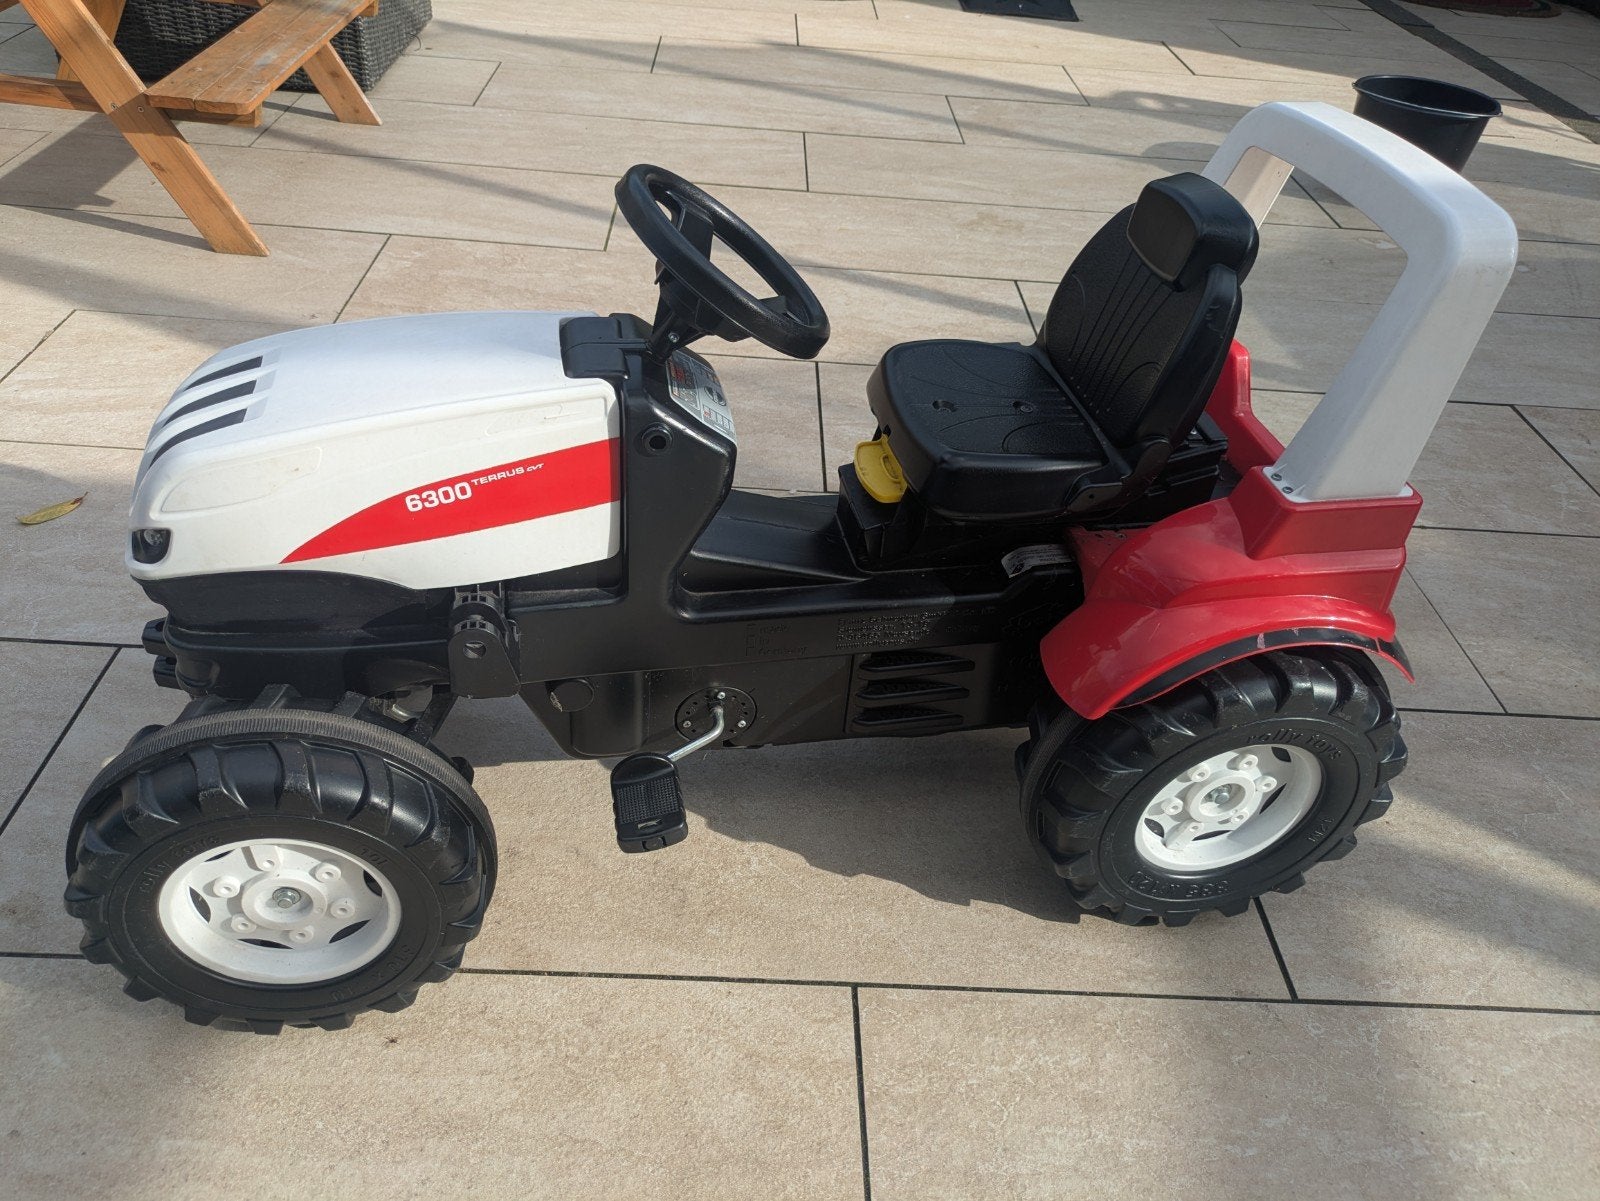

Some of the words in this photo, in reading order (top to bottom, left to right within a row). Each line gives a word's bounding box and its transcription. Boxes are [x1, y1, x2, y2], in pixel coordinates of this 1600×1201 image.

[405, 481, 472, 512] 6300
[471, 466, 525, 486] TERRUS
[1246, 728, 1304, 744] rolly
